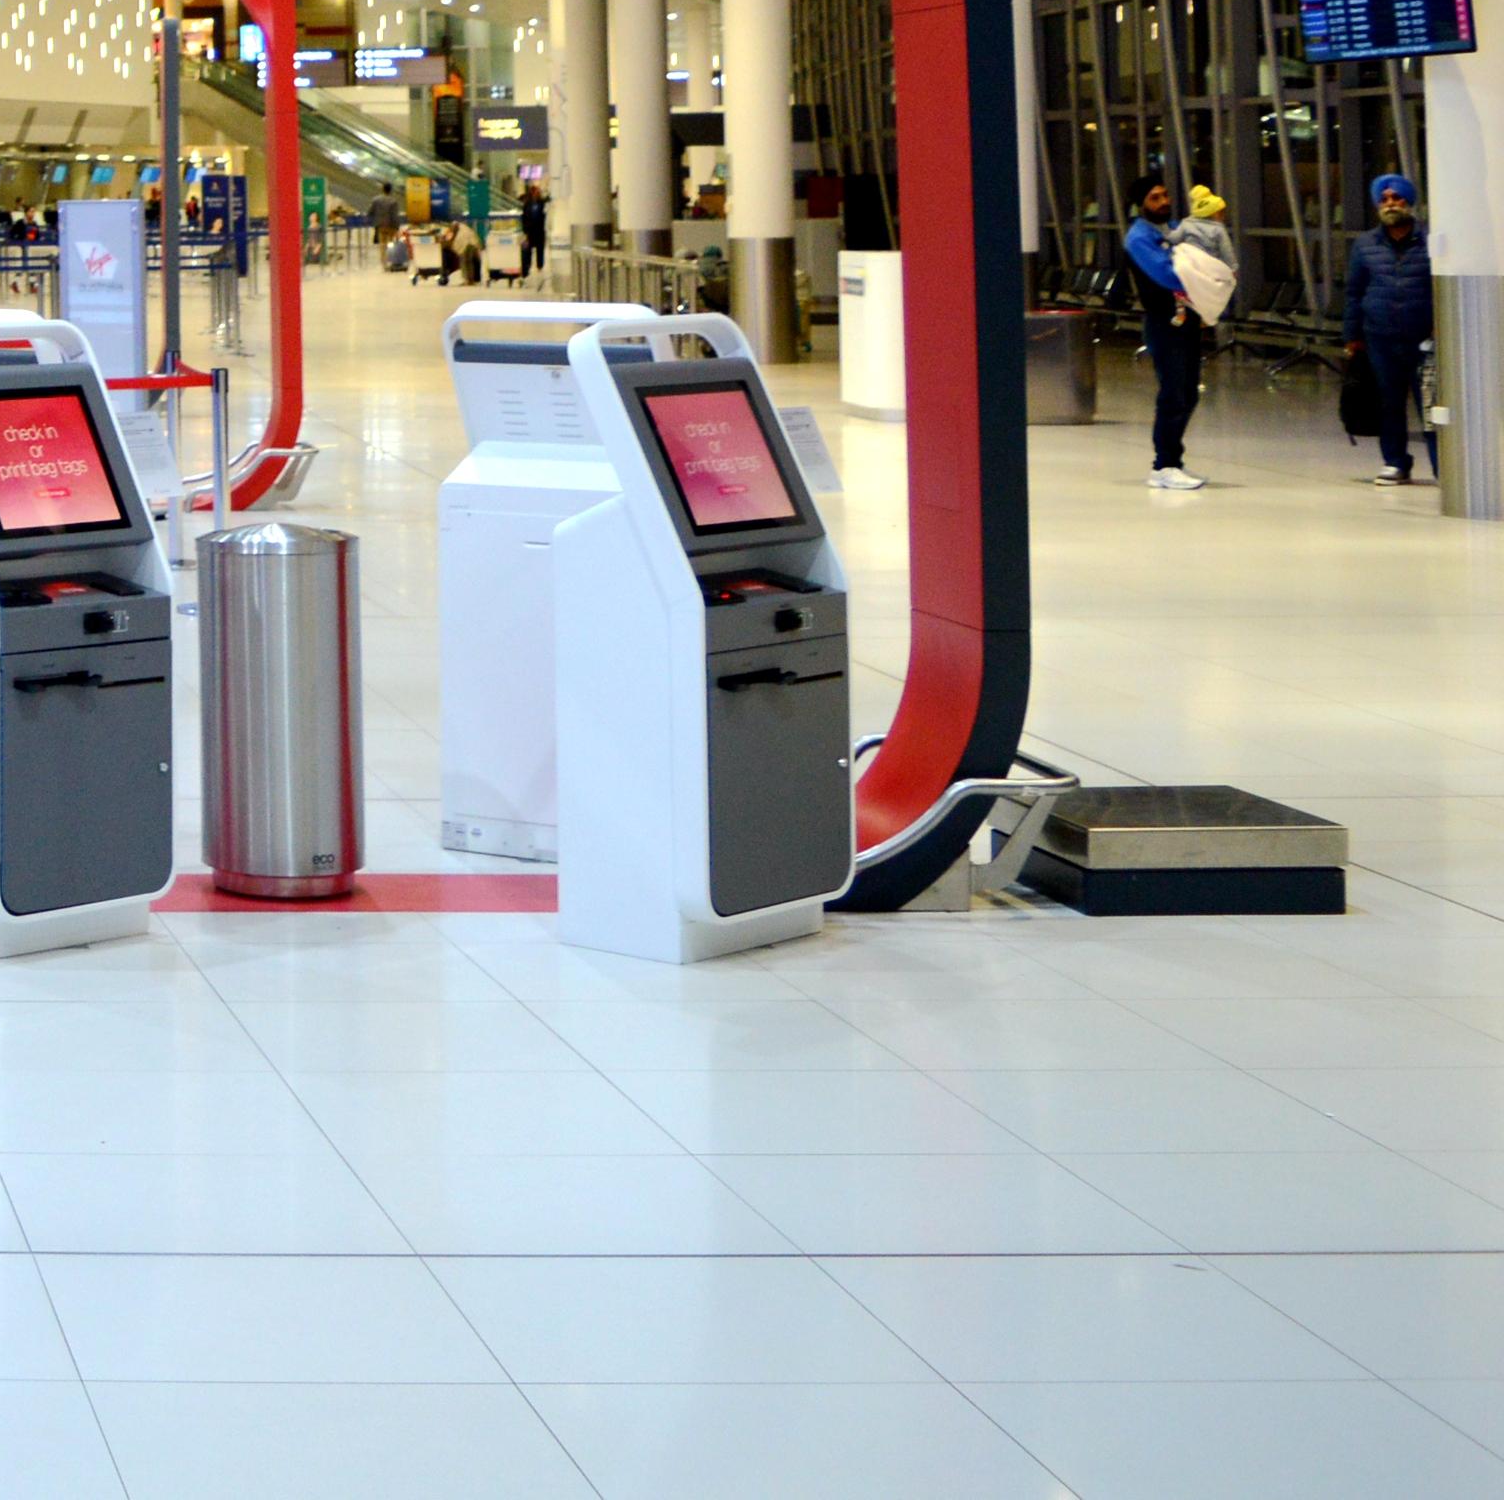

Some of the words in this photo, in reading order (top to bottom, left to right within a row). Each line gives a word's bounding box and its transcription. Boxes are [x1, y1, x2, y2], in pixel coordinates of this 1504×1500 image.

[3, 424, 43, 442] check
[44, 424, 58, 439] in
[29, 444, 44, 458] or
[30, 460, 56, 478] bag
[57, 458, 88, 477] tags
[312, 854, 336, 865] eco
